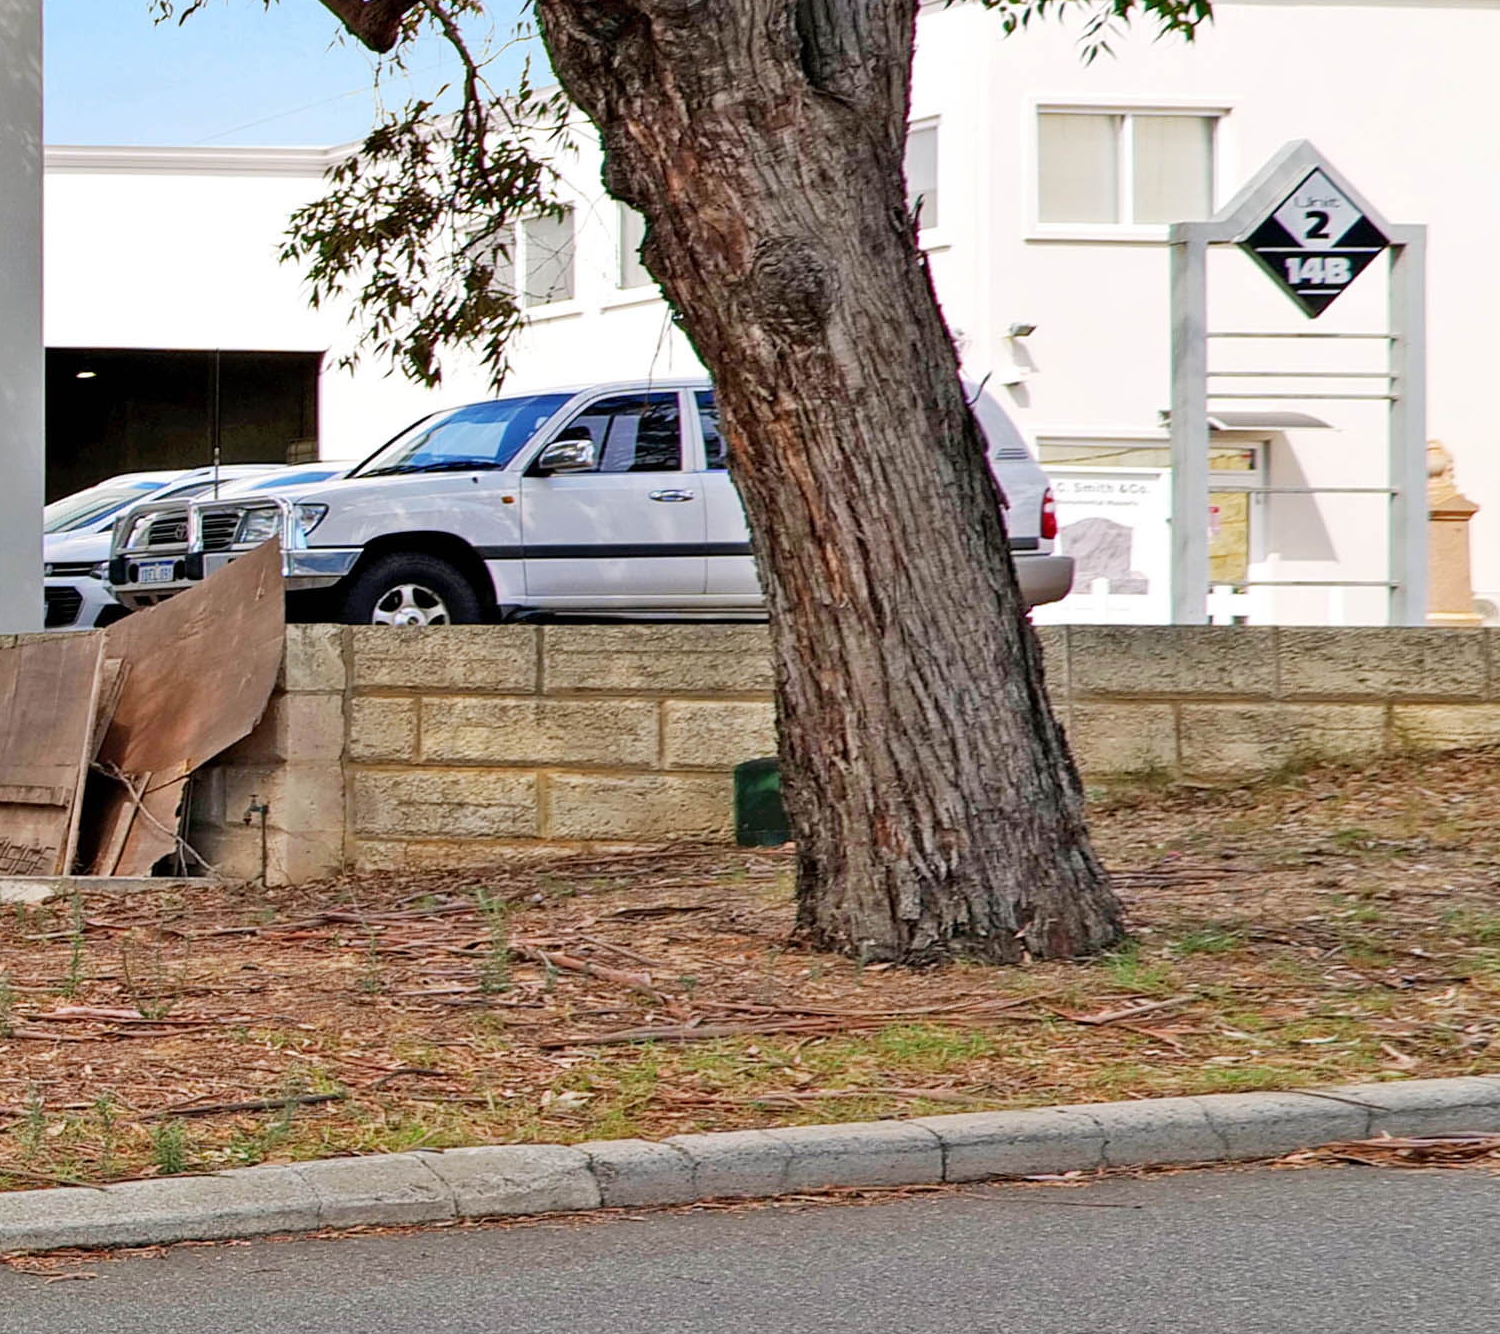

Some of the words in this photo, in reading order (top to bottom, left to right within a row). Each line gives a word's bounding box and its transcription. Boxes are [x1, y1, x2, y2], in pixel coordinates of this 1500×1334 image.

[1293, 196, 1341, 208] Unit
[1304, 210, 1331, 240] 2
[1284, 257, 1351, 285] 14B
